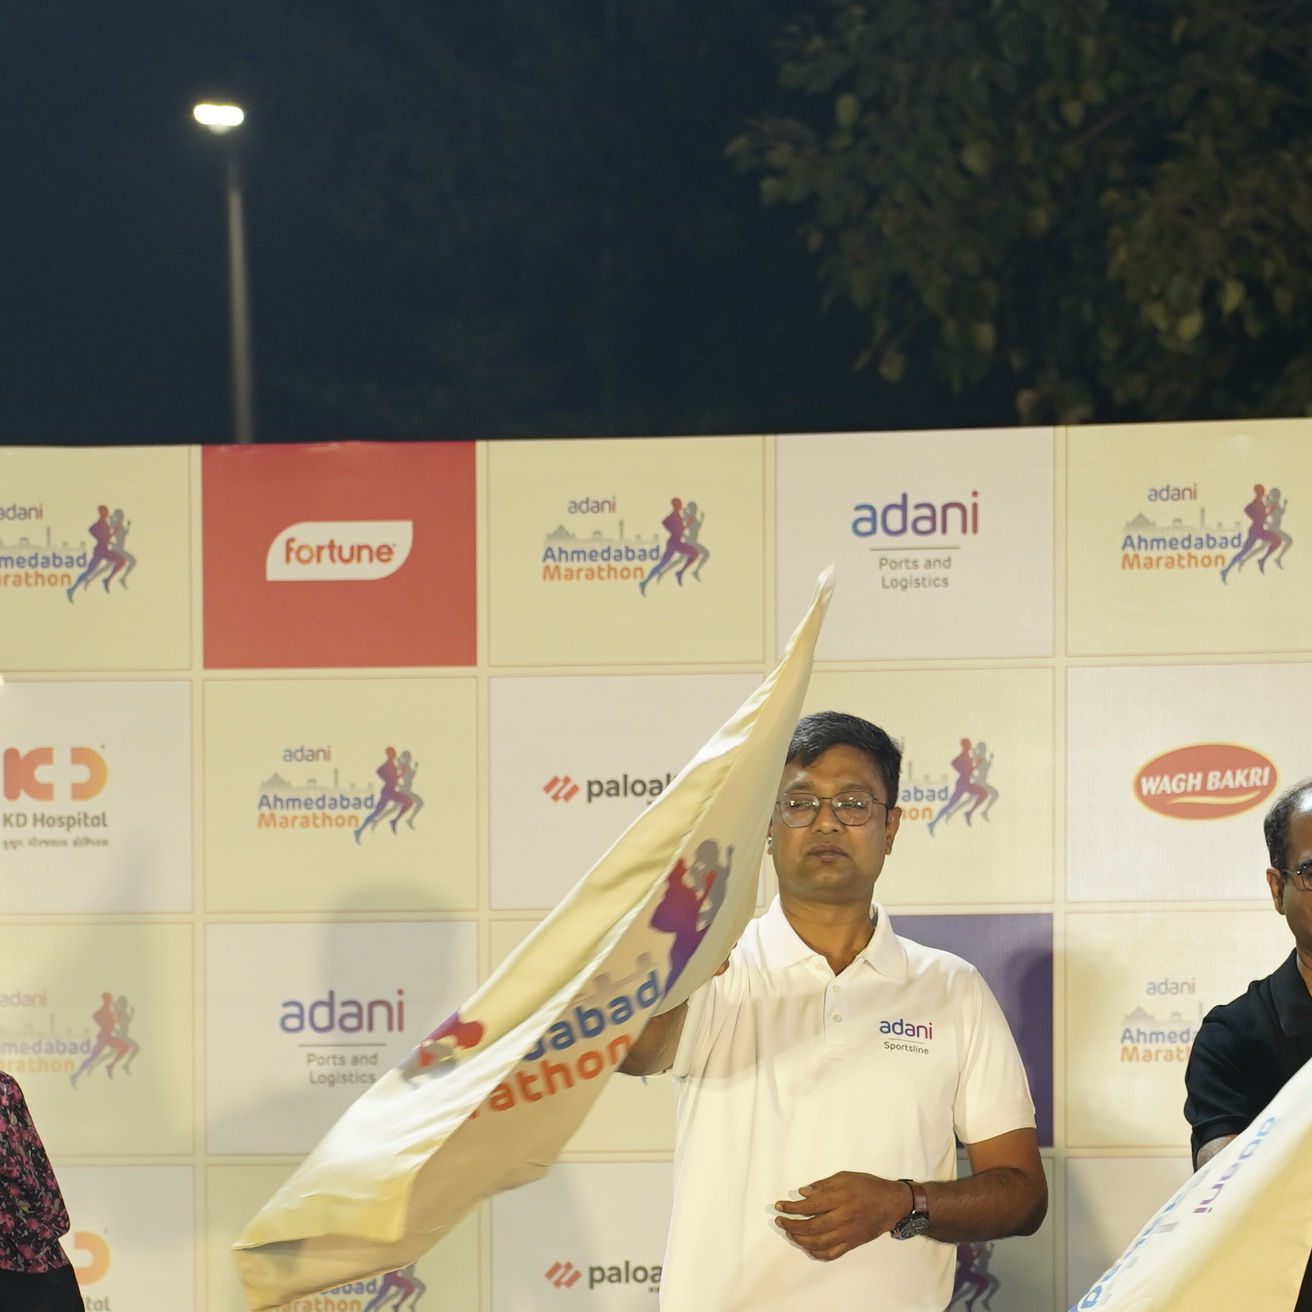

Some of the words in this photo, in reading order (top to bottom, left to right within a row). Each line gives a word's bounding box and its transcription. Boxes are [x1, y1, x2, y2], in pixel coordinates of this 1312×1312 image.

[1148, 484, 1198, 503] adani
[567, 497, 616, 515] adani
[852, 491, 979, 537] adani
[285, 537, 394, 565] fortune
[1122, 532, 1242, 552] Ahmedabad
[543, 545, 660, 563] Ahmedabad
[879, 556, 915, 571] Ports
[922, 555, 951, 570] and
[1122, 552, 1226, 571] Marathon
[543, 563, 645, 581] Marathon
[881, 573, 950, 592] Logistics
[283, 745, 331, 763] adani
[1140, 771, 1203, 798] WAGH
[1205, 765, 1270, 794] BAKRI
[258, 793, 375, 812] Ahmedabad
[3, 813, 27, 827] KD
[33, 811, 108, 832] Hospital
[258, 812, 359, 829] Marathon
[1146, 978, 1195, 996] adani
[0, 990, 48, 1007] adani
[280, 990, 404, 1034] adani
[879, 1018, 932, 1040] adani
[1120, 1027, 1196, 1044] Ahmed
[884, 1041, 929, 1054] Sportsline
[306, 1054, 343, 1069] Ports
[349, 1052, 379, 1067] and
[309, 1071, 376, 1087] Logistics
[588, 1260, 664, 1290] paloa
